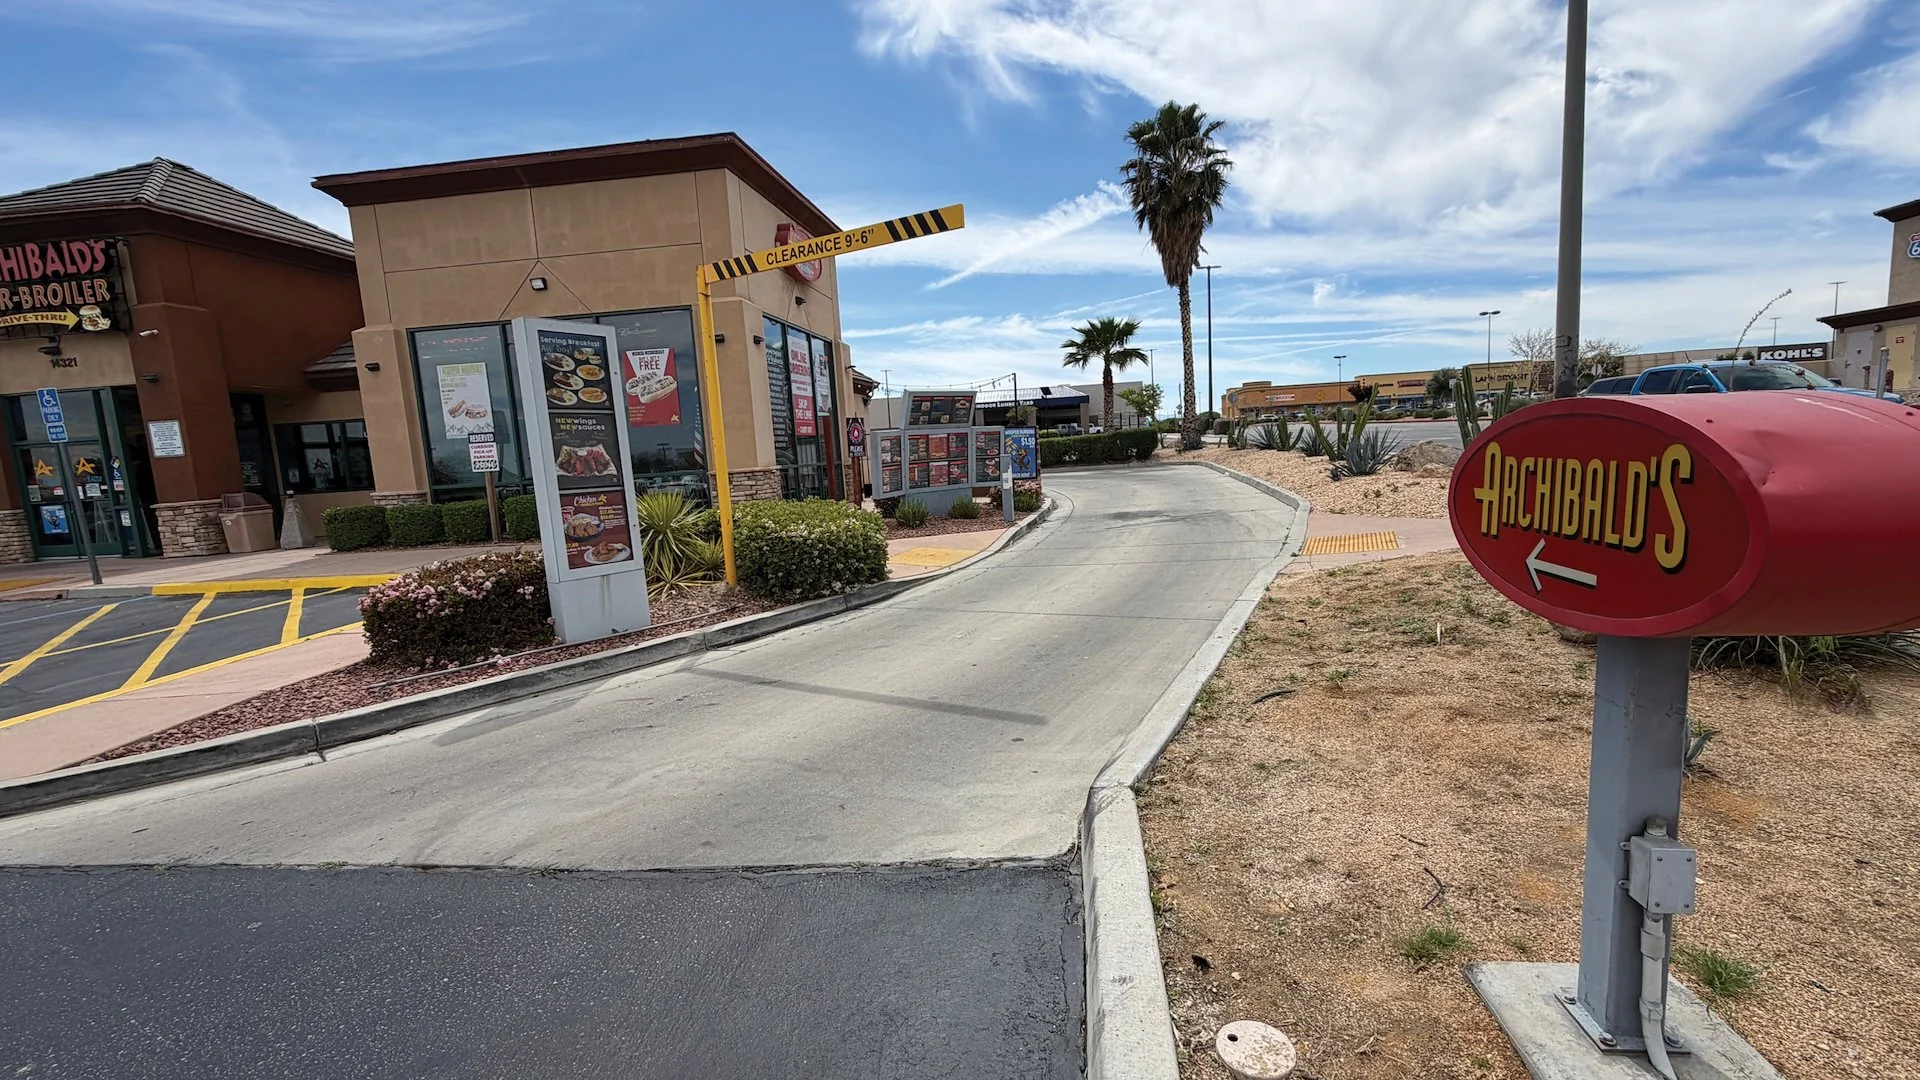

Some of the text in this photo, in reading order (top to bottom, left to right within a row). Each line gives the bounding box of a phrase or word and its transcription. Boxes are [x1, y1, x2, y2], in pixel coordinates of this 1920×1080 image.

[766, 228, 874, 266] CLEARANCE 9'-6"
[540, 336, 600, 347] Serving Breakfast
[1760, 347, 1824, 360] KOHL'S
[50, 357, 78, 369] 14321
[639, 360, 661, 371] FREE
[798, 398, 808, 409] SKIP
[470, 434, 494, 442] RESERVED
[574, 495, 597, 507] Chicken
[1474, 442, 1692, 572] ARCHIBALD'S
